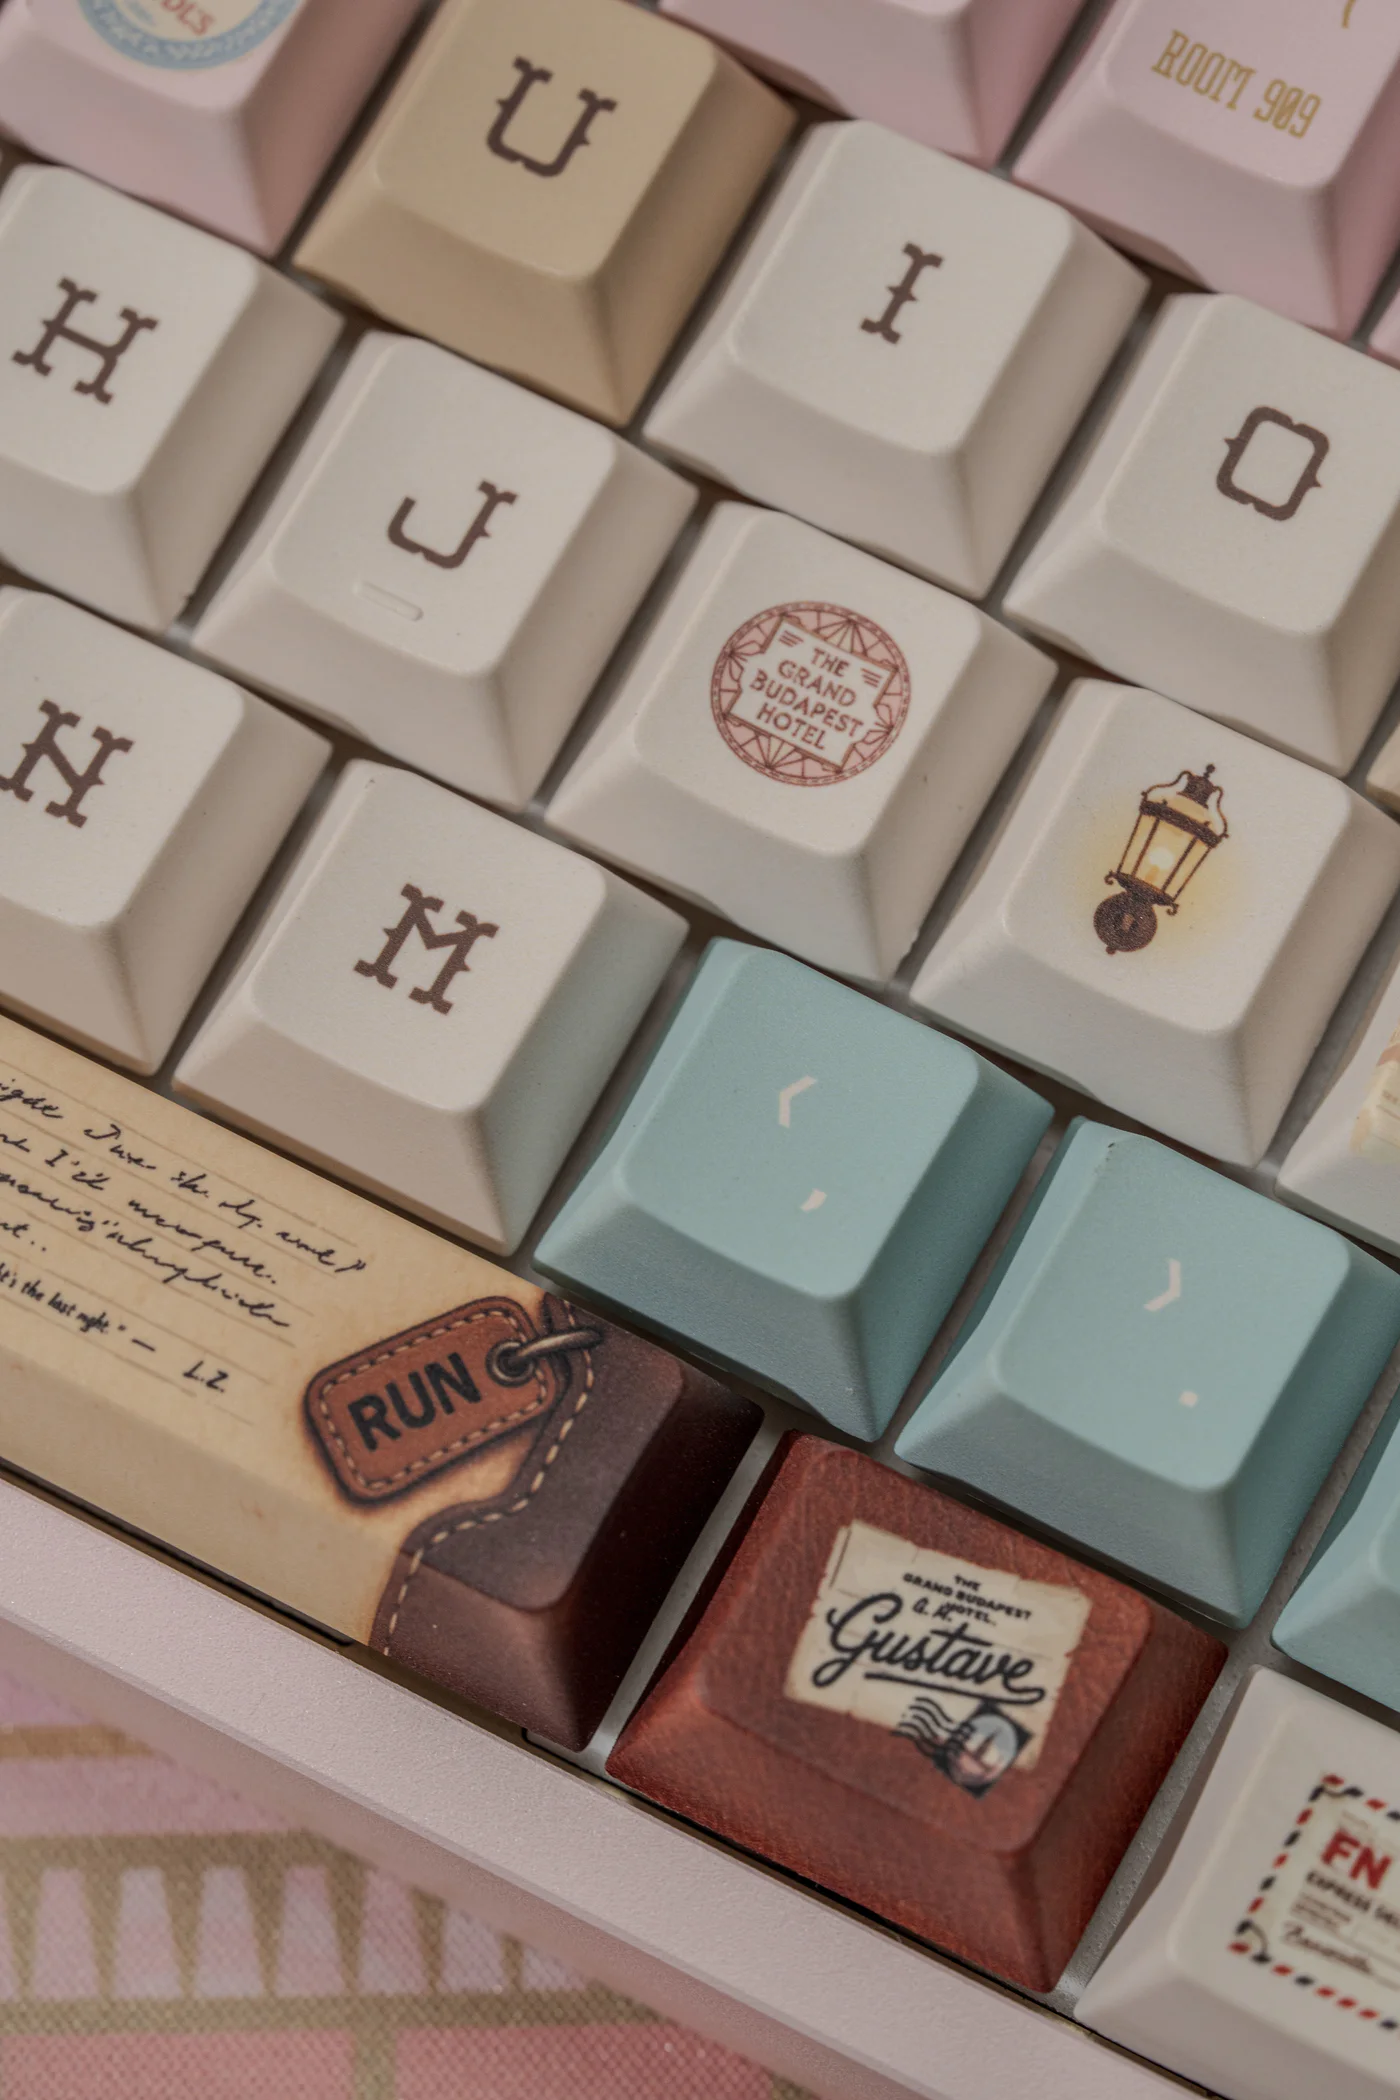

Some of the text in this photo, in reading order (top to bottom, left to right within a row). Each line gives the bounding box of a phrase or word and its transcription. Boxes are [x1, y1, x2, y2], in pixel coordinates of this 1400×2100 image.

[487, 56, 617, 178] U
[1151, 29, 1322, 139] ROOM 909
[12, 277, 158, 405] H
[861, 242, 945, 345] I
[1216, 406, 1330, 521] O
[388, 480, 517, 569] J
[749, 669, 864, 738] BUDAPEST
[778, 659, 857, 707] GRAND
[810, 648, 850, 678] THE
[0, 700, 134, 828] N
[756, 702, 826, 750] HOTEL
[354, 883, 499, 1015] M
[347, 1352, 482, 1452] RUN
[903, 1573, 1032, 1619] GRAND BUDAPEST
[954, 1574, 981, 1591] THE
[812, 1592, 1046, 1702] Gustave
[1320, 1827, 1393, 1890] FN
